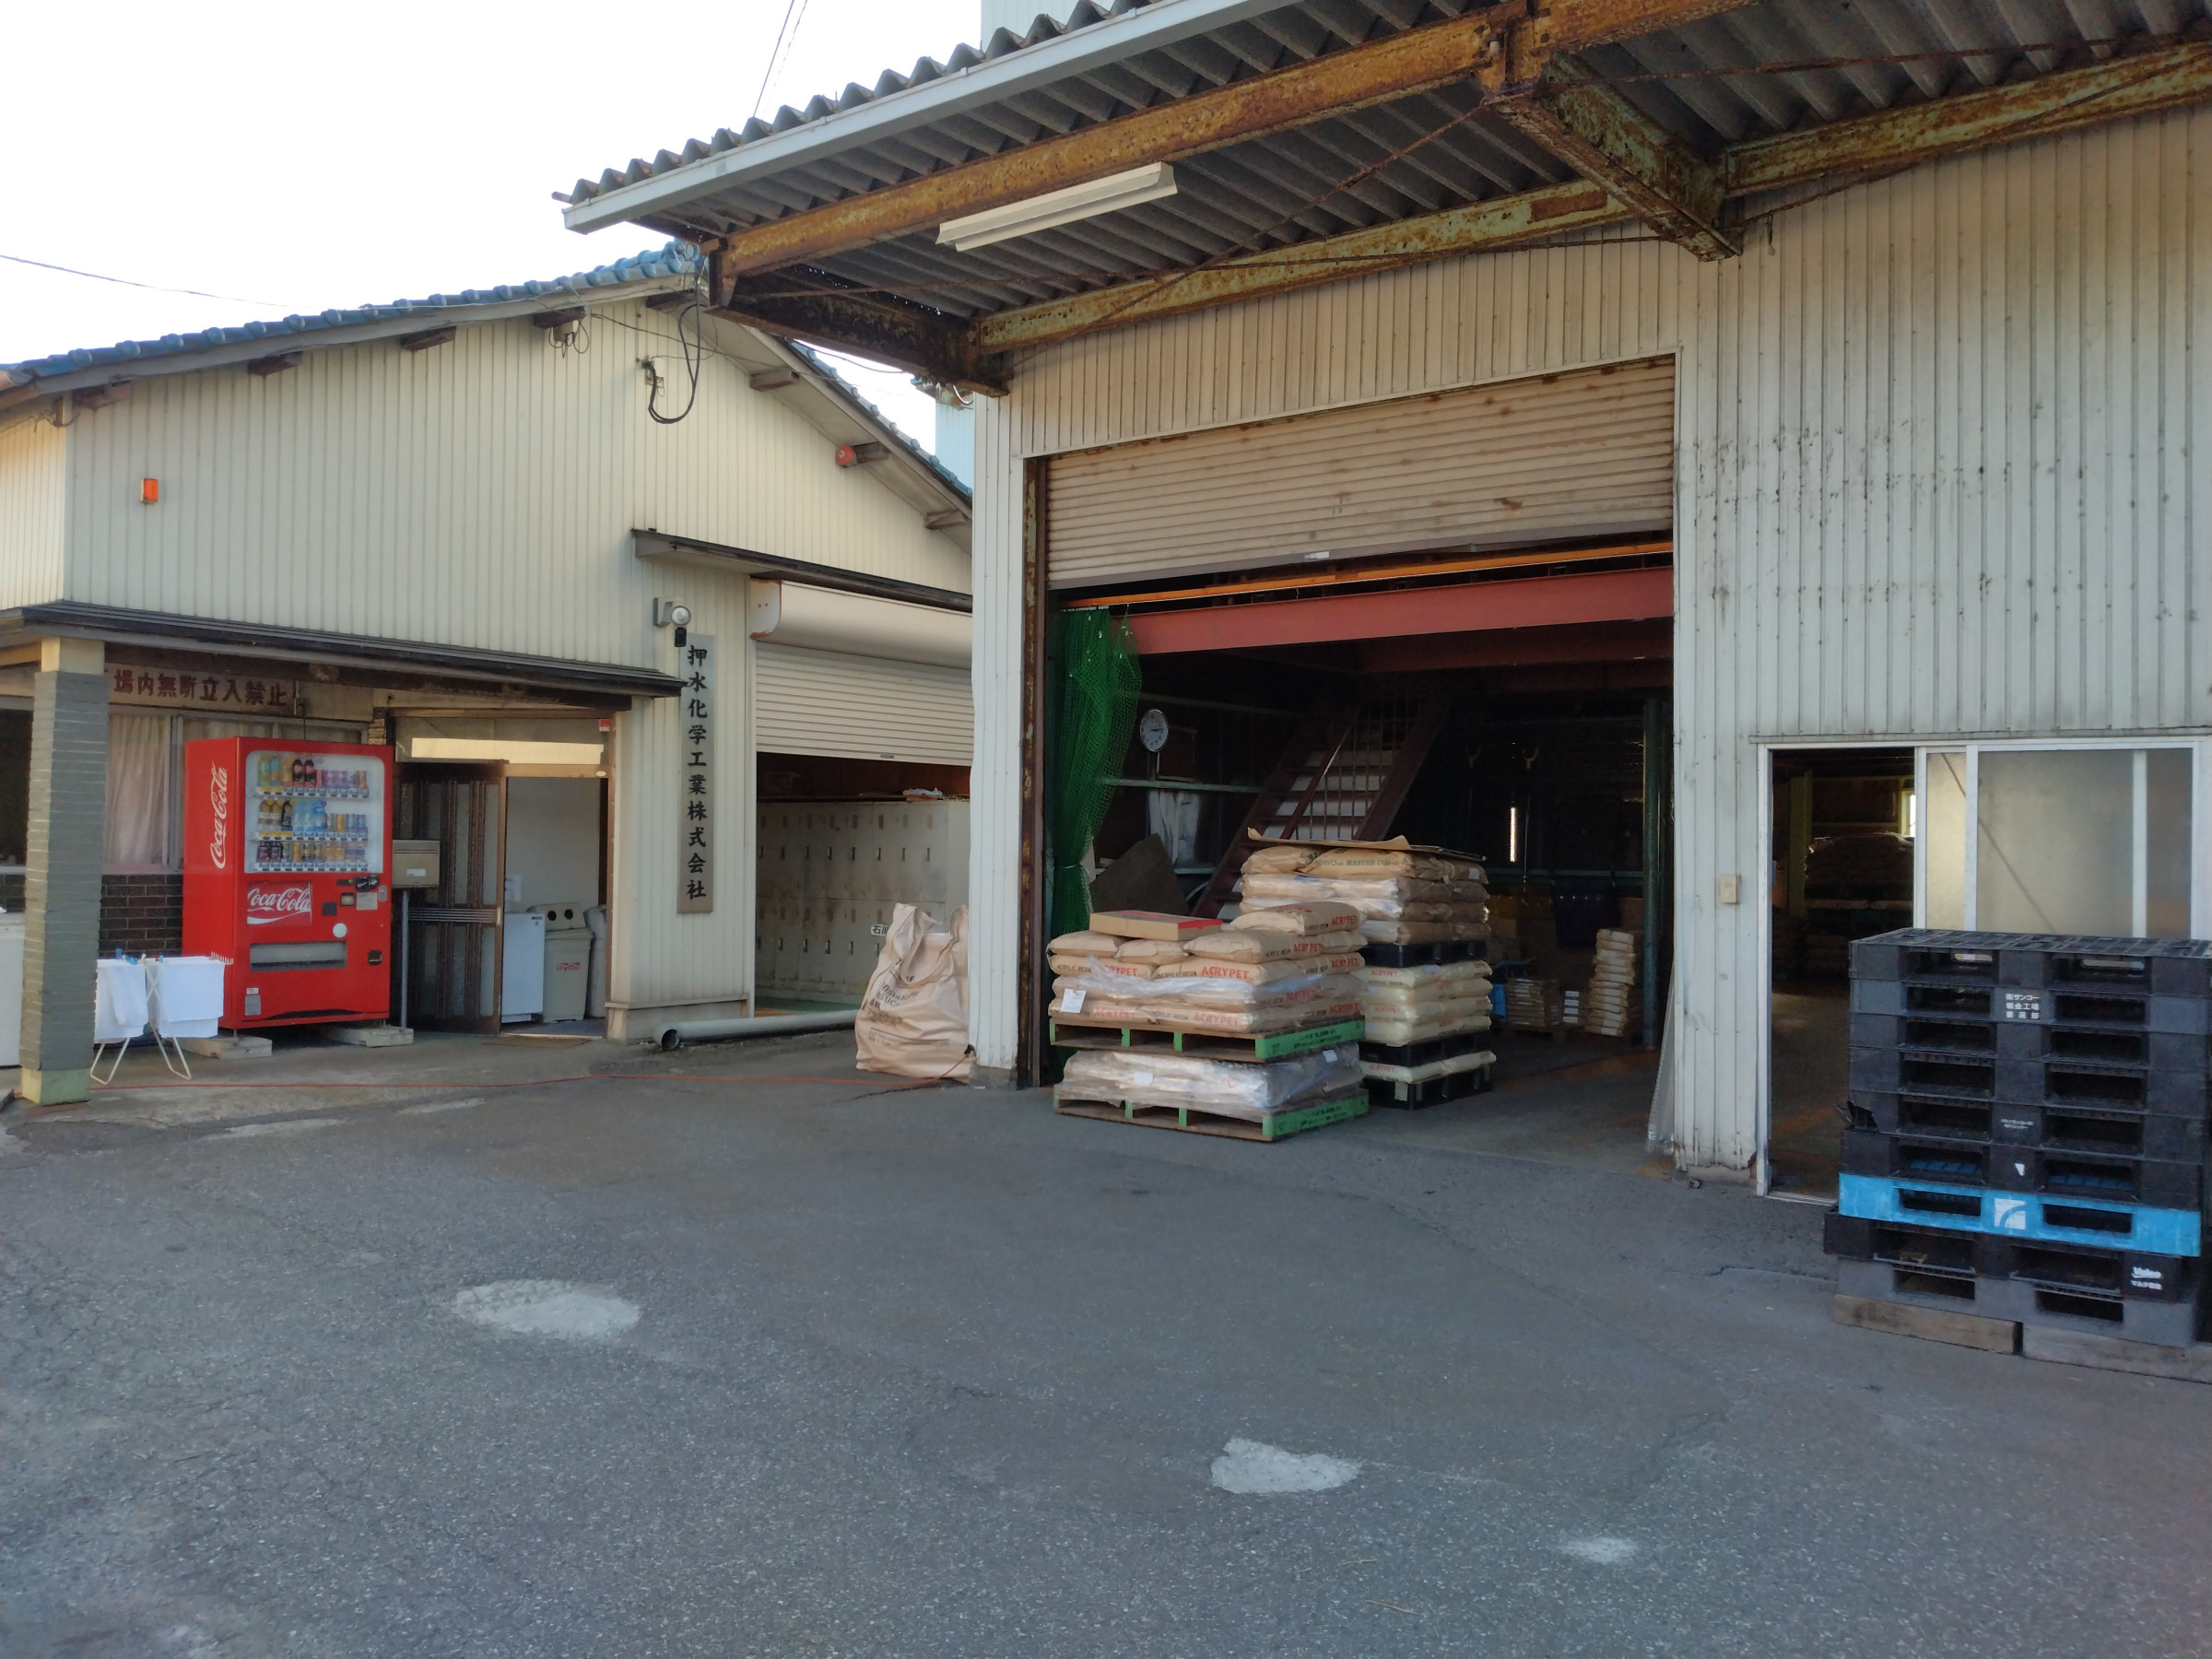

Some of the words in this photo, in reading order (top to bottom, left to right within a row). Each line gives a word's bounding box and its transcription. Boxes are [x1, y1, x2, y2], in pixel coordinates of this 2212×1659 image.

[104, 668, 288, 707] 場内無断立入禁止
[687, 644, 708, 900] 押水化学工業株式会社
[1331, 915, 1358, 926] ACRYPET
[1293, 943, 1322, 952] ACRYPET
[1056, 964, 1076, 972] ACRYLIC
[1331, 958, 1359, 969] ACRYPET
[1201, 966, 1249, 980] ACRYPET
[1330, 1003, 1359, 1014] ACRYPET
[1194, 1013, 1239, 1026] ACRYPET
